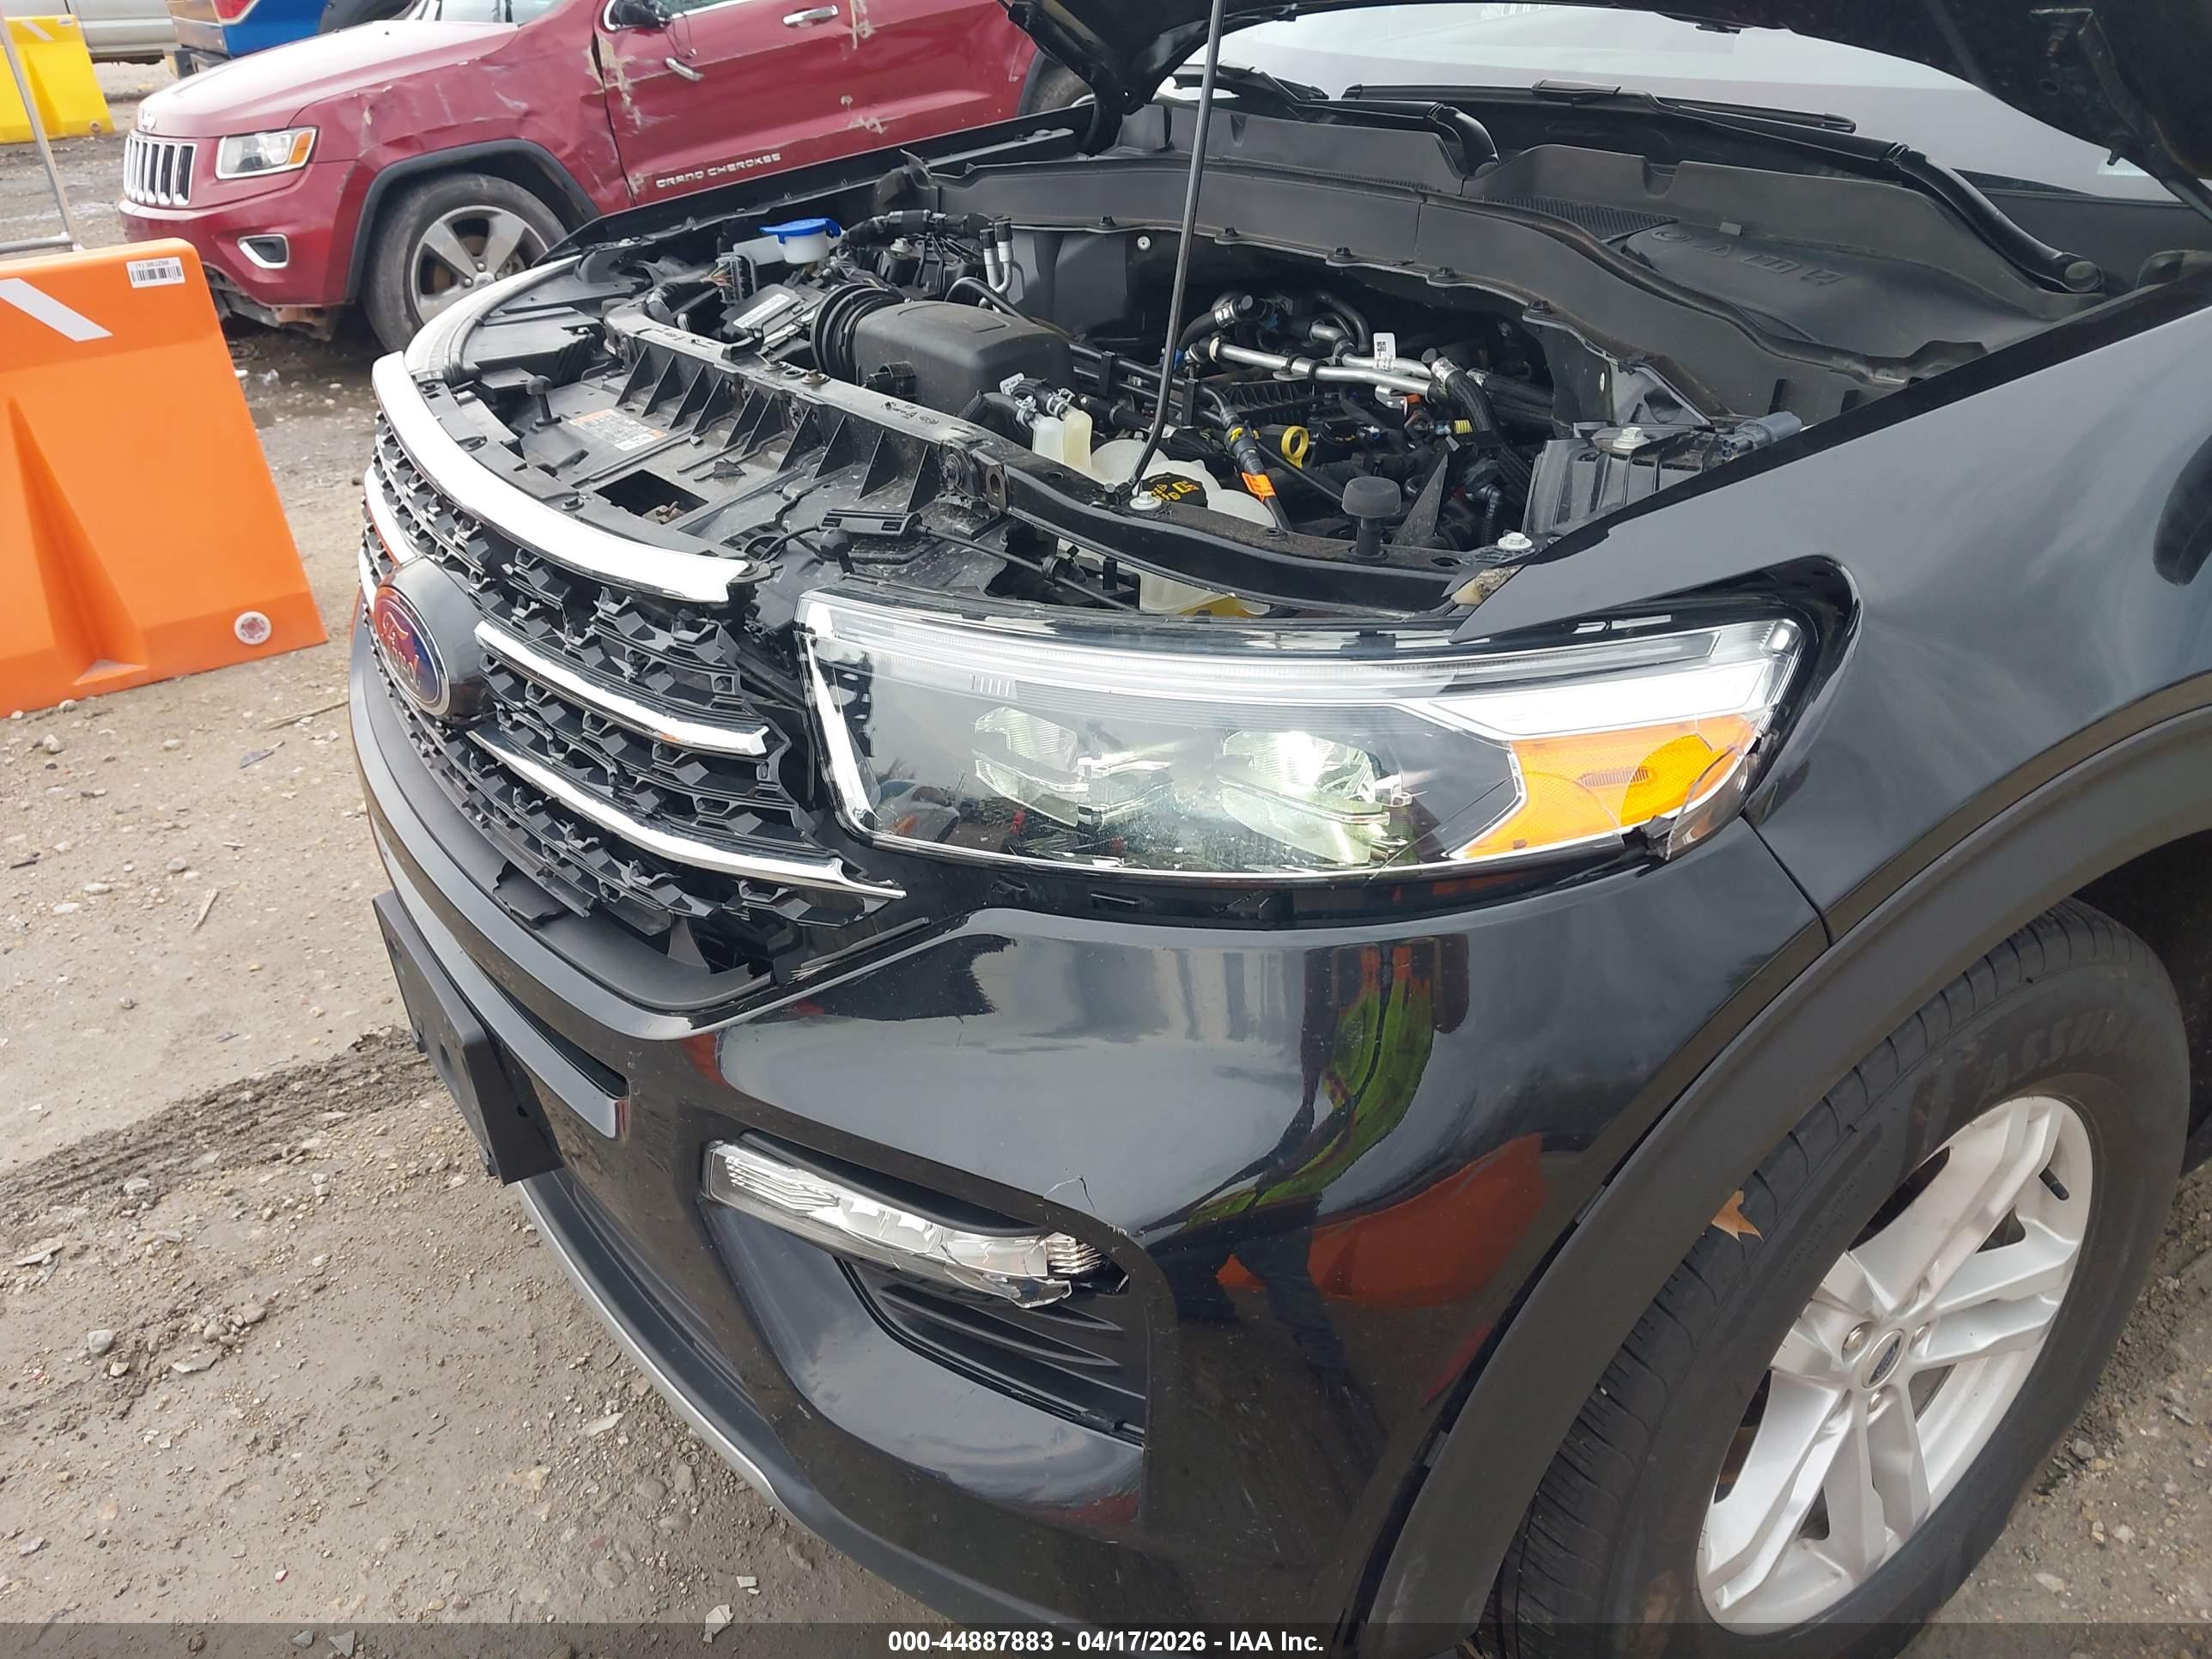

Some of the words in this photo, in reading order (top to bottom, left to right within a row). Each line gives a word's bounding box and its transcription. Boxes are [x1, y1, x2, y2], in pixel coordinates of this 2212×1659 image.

[655, 170, 705, 188] GRAND
[707, 152, 781, 177] CHEROKEE
[380, 611, 421, 691] Ford
